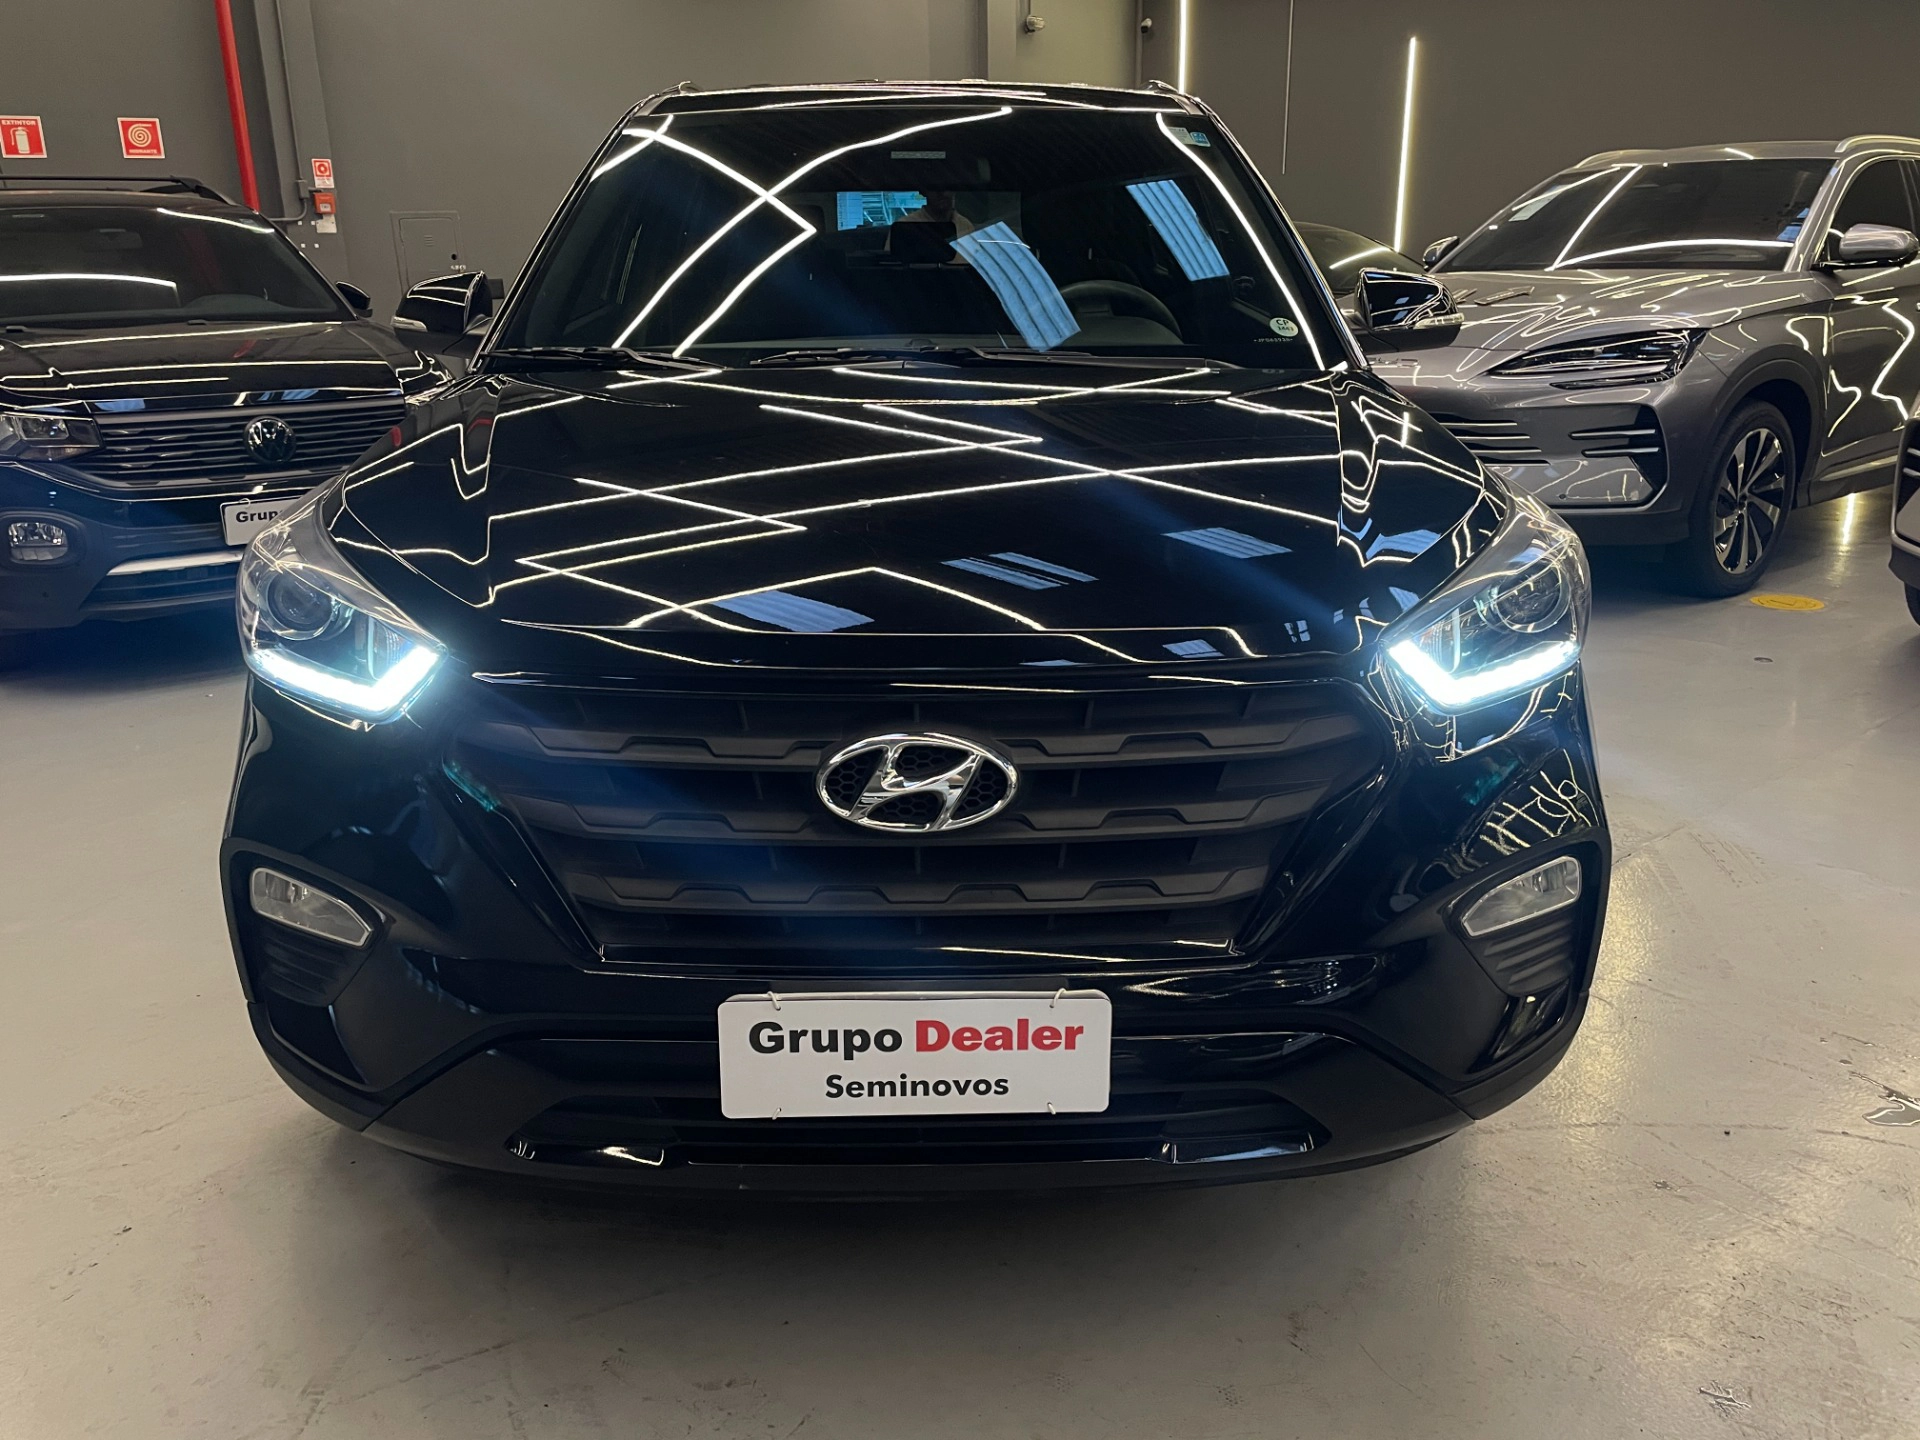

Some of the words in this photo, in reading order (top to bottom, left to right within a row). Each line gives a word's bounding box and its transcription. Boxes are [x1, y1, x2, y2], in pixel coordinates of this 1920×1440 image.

[235, 510, 283, 522] Grup
[748, 1021, 902, 1061] Grupo
[915, 1018, 1084, 1052] Dealer
[825, 1073, 1009, 1099] Seminovos
